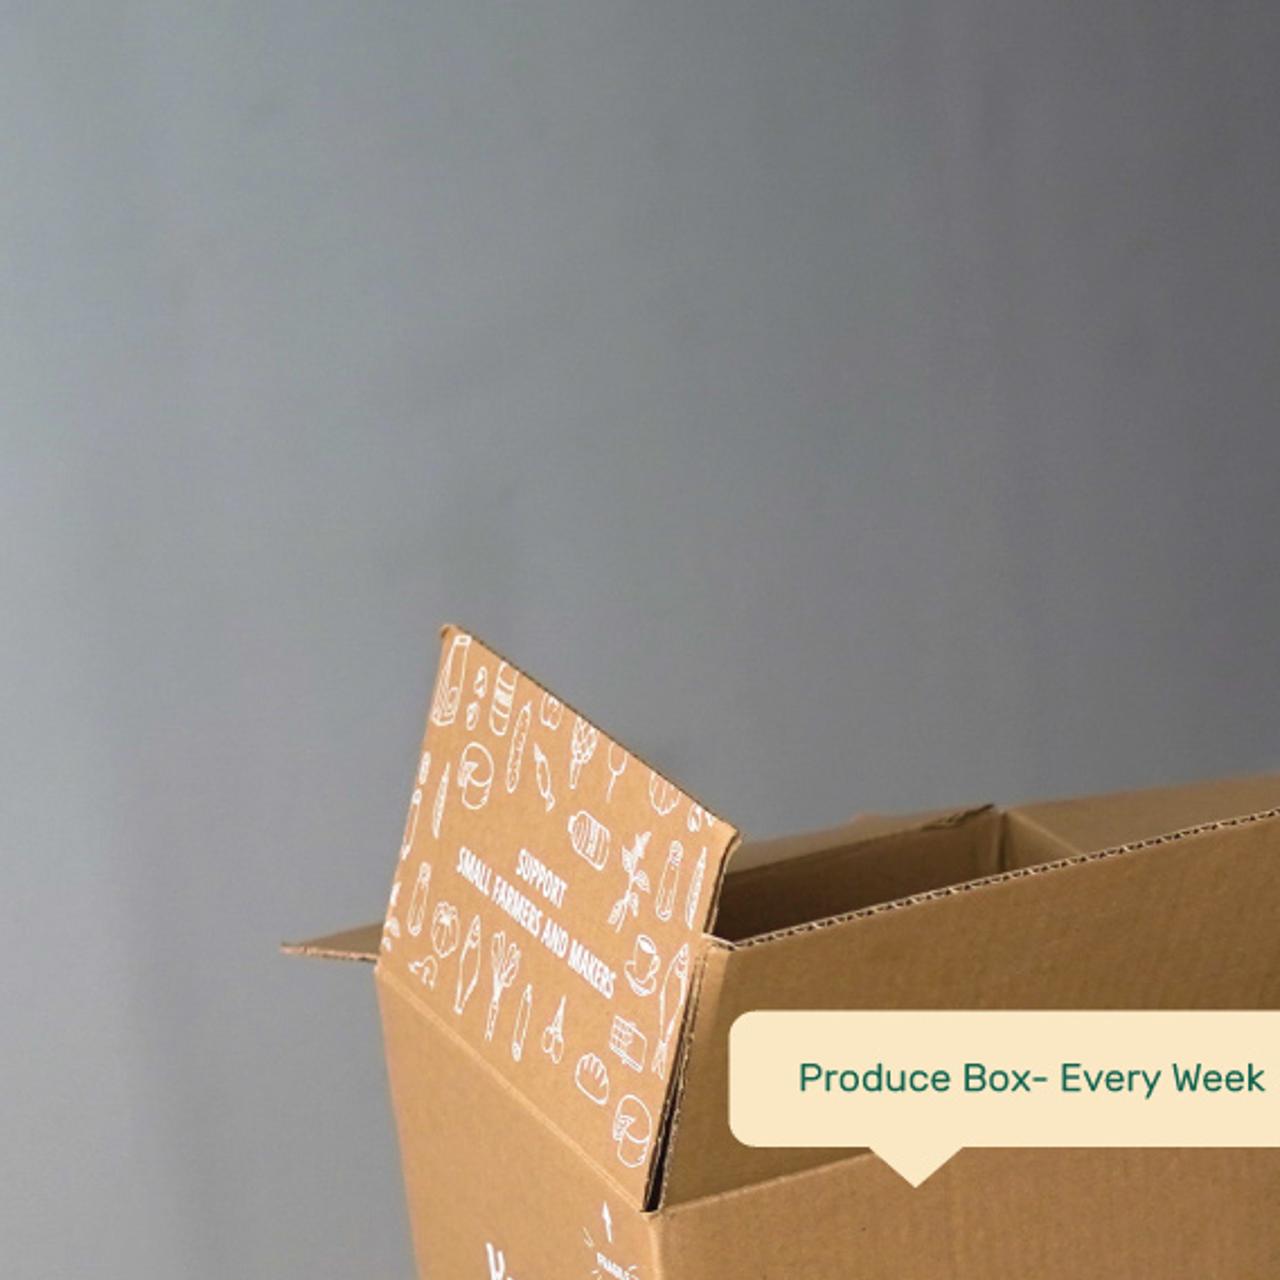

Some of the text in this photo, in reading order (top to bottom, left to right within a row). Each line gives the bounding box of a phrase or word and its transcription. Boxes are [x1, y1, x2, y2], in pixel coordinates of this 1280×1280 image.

[456, 847, 617, 999] SMALL FARMERS AND MAKERS
[516, 848, 568, 909] SUPPORT
